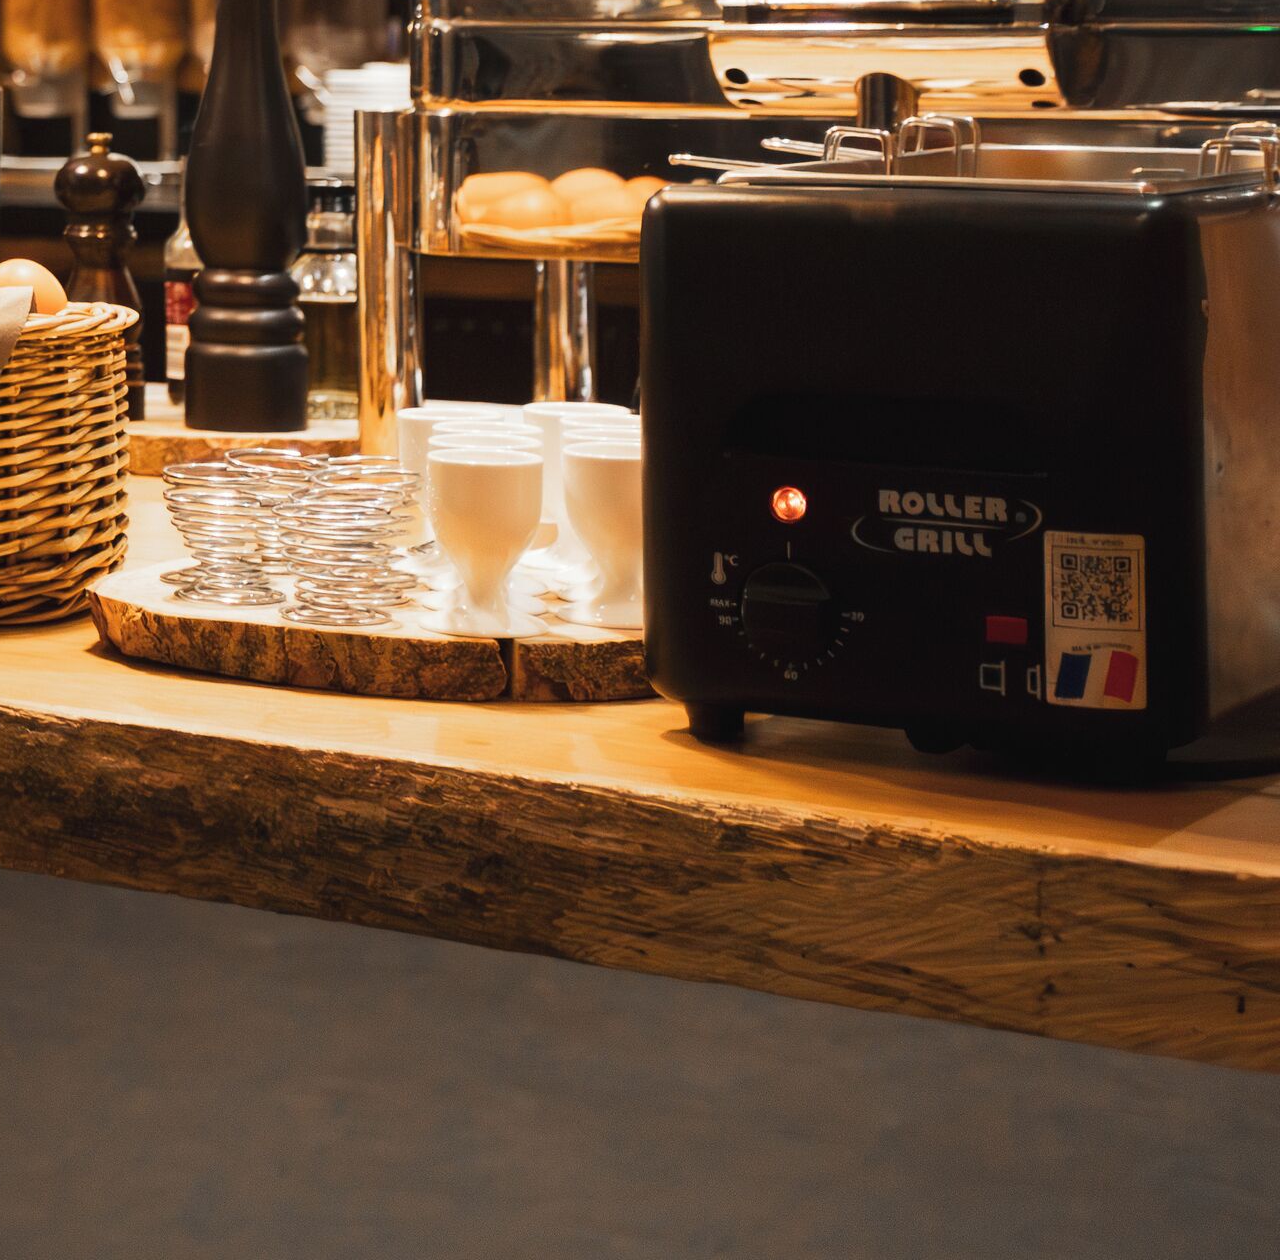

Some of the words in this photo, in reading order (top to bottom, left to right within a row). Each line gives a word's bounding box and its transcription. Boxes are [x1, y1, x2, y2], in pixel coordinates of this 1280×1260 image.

[878, 489, 1008, 523] ROLLER
[893, 527, 993, 558] GRILL
[709, 597, 730, 609] MAX
[783, 669, 799, 681] 60
